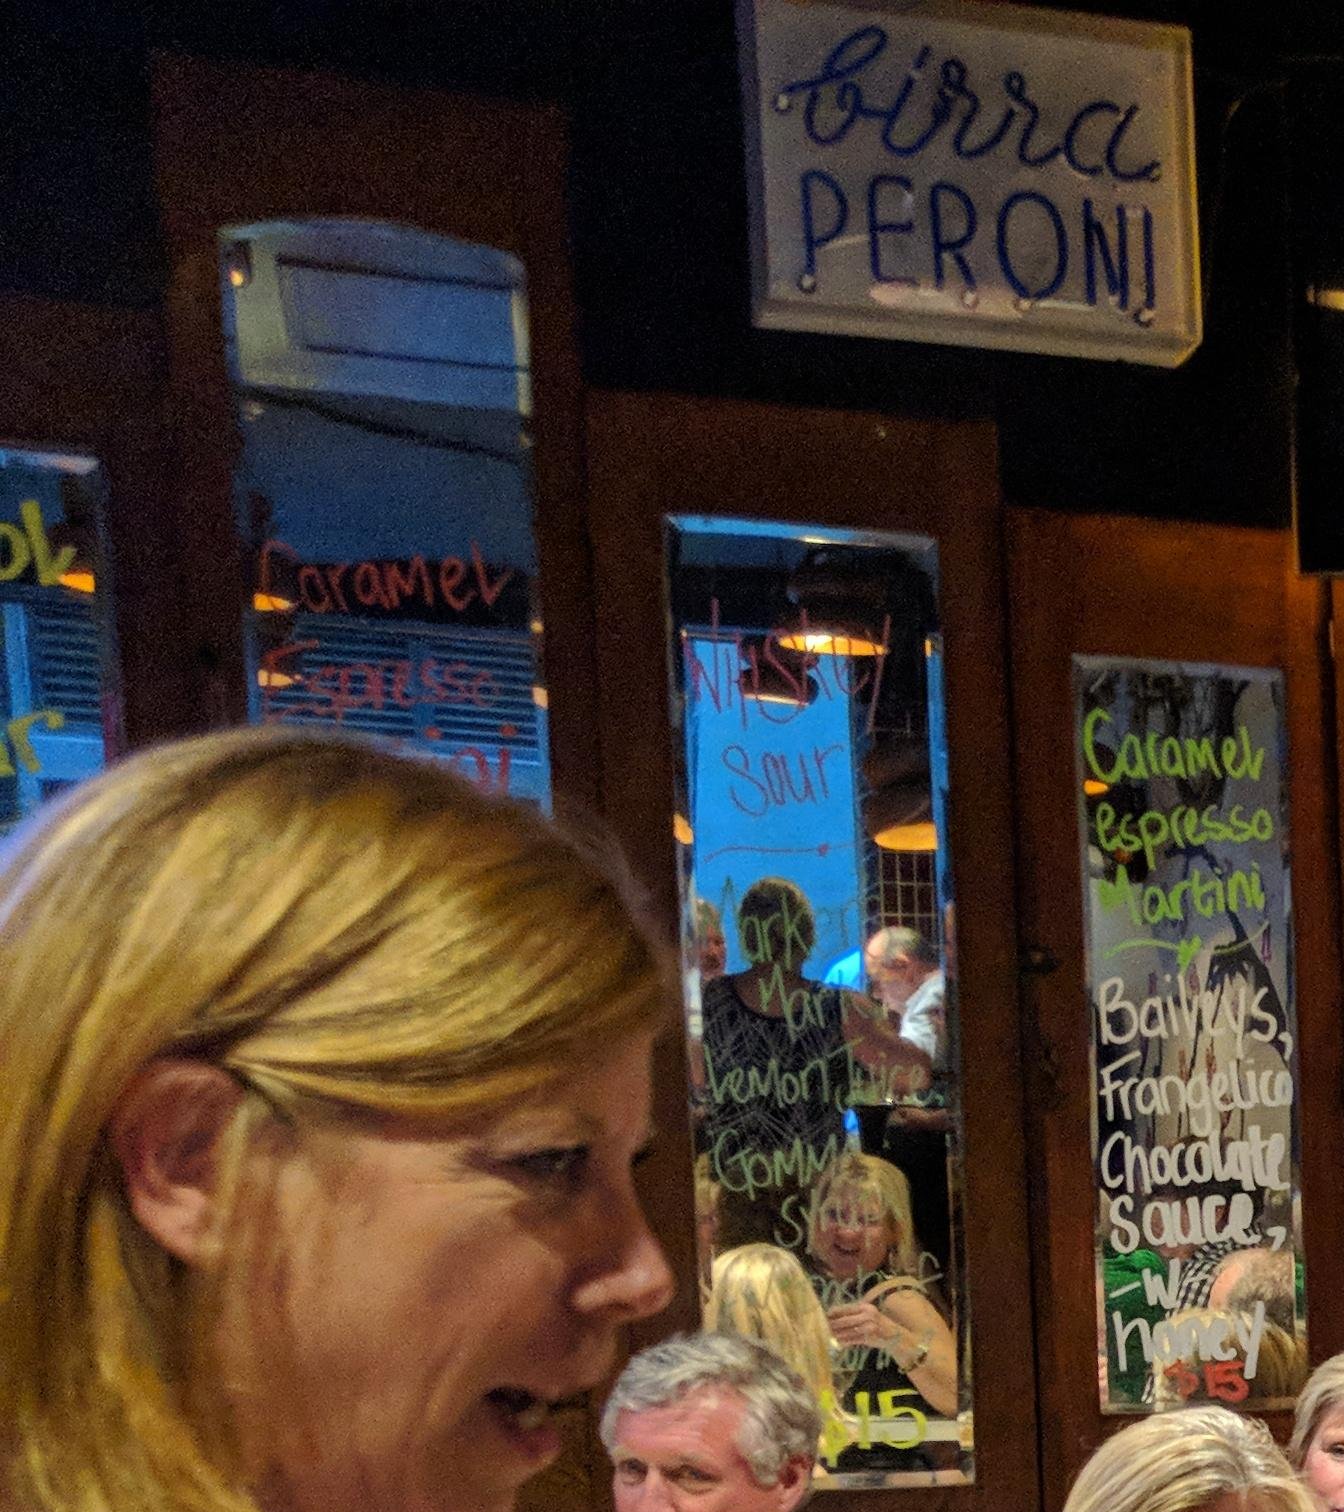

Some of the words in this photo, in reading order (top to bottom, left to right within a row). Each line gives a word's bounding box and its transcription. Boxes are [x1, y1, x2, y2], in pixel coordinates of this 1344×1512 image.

[781, 24, 1162, 183] birra
[801, 167, 1157, 312] PERONI
[1083, 707, 1265, 784] Caramel
[1095, 801, 1275, 872] espresso
[1096, 862, 1267, 927] Martini
[1099, 1049, 1295, 1138] Frangelico
[1100, 1123, 1291, 1194] Chocolate
